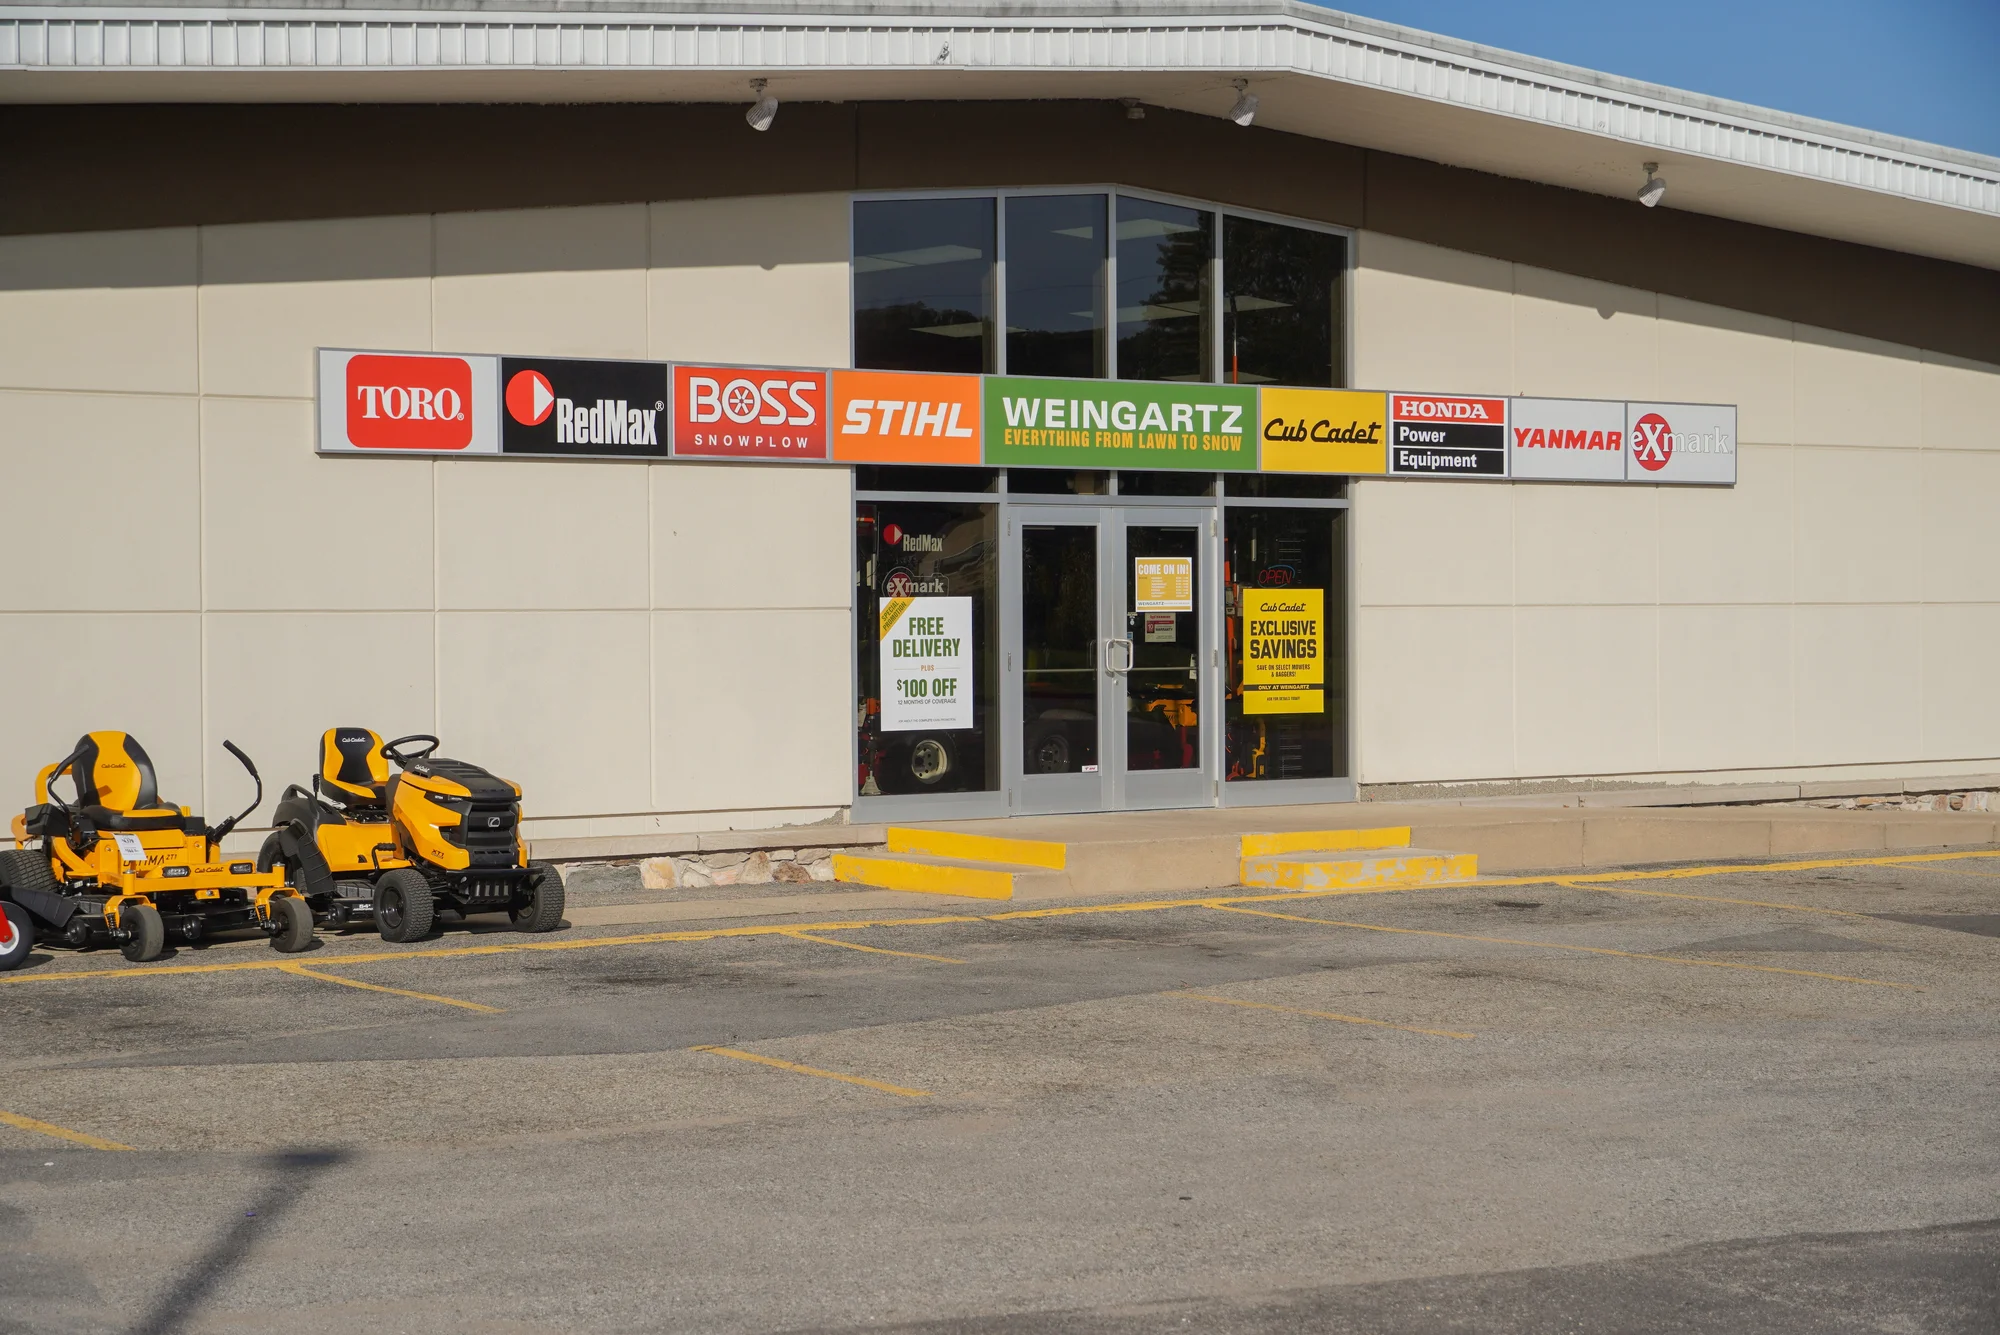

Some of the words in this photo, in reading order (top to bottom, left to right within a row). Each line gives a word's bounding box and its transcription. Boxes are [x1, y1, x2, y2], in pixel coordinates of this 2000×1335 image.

[357, 385, 460, 421] TORO
[689, 376, 817, 426] BOSS
[1400, 401, 1488, 420] HONDA
[556, 398, 657, 445] RedMax
[842, 399, 973, 438] STIHL
[1003, 397, 1243, 434] WEINGARTZ
[694, 433, 809, 449] SNOWPLOW
[1004, 428, 1090, 447] EVERYTHING
[1095, 431, 1134, 449] FROM
[1139, 432, 1177, 450] LAWN
[1182, 433, 1198, 451] TO
[1202, 434, 1242, 452] SNOW
[1264, 418, 1307, 443] Cub
[1310, 421, 1381, 445] Cadet
[1400, 427, 1446, 444] Power
[1513, 428, 1622, 452] YANMAR
[1400, 451, 1477, 470] Equipment
[903, 534, 943, 552] RedMax
[1138, 564, 1161, 575] COME
[1163, 564, 1175, 574] ON
[1176, 564, 1189, 574] IN!
[1258, 569, 1292, 584] OPEN
[882, 600, 899, 621] SPECIAL
[882, 601, 907, 631] PROMOTION
[1260, 602, 1277, 612] Cub
[1278, 602, 1306, 612] Cadet
[909, 617, 945, 636] FREE
[1250, 620, 1317, 636] EXCLUSIVE
[893, 638, 961, 658] DELIVERY
[1250, 639, 1317, 659] SAVINGS
[896, 678, 928, 698] $100
[932, 677, 957, 697] OFF
